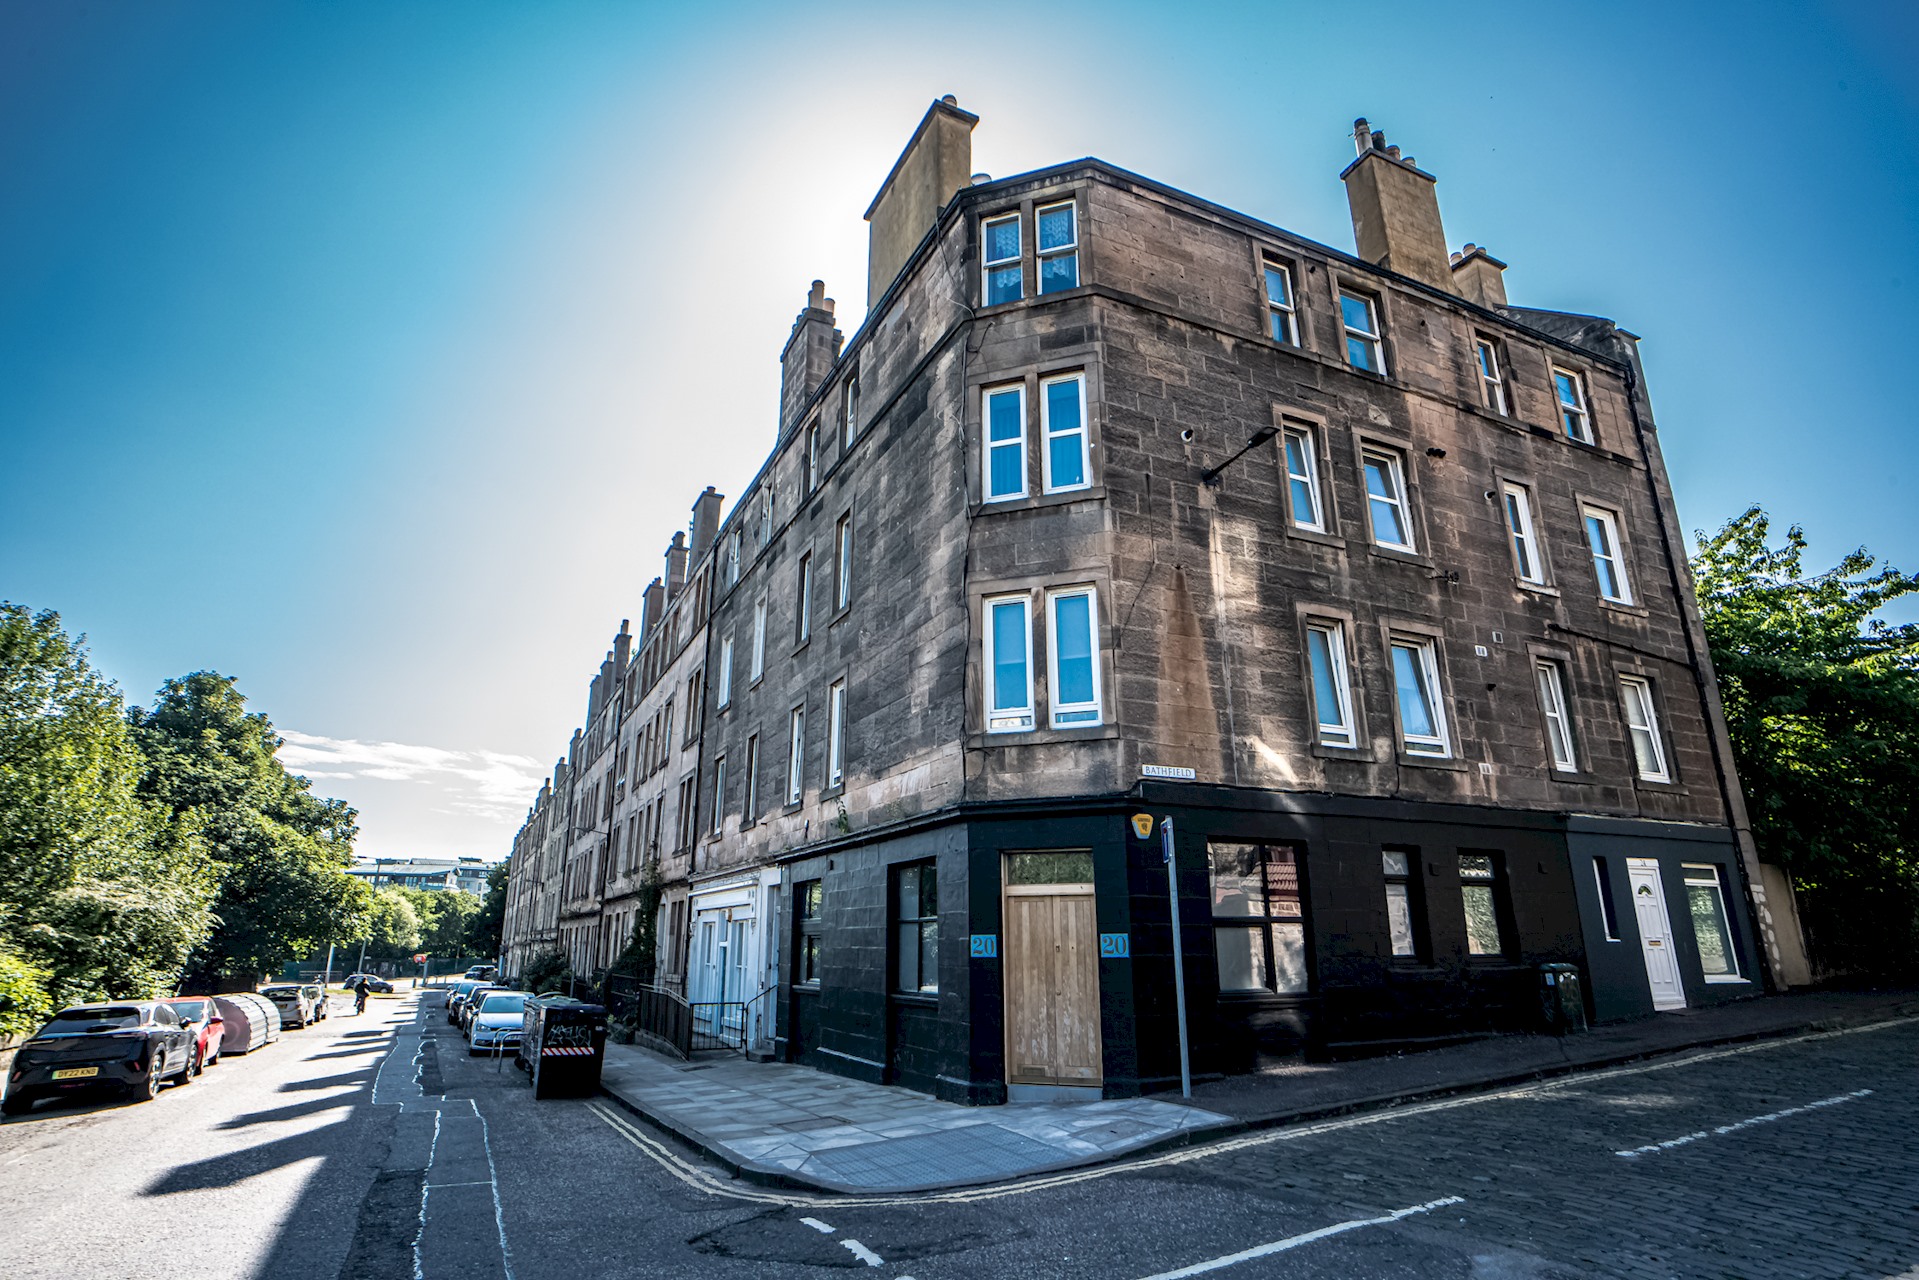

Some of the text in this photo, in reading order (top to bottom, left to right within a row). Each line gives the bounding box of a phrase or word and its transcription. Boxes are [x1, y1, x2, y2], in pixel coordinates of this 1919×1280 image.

[1145, 766, 1192, 777] BATHFIELD
[973, 937, 995, 955] 20
[1103, 935, 1127, 955] 20
